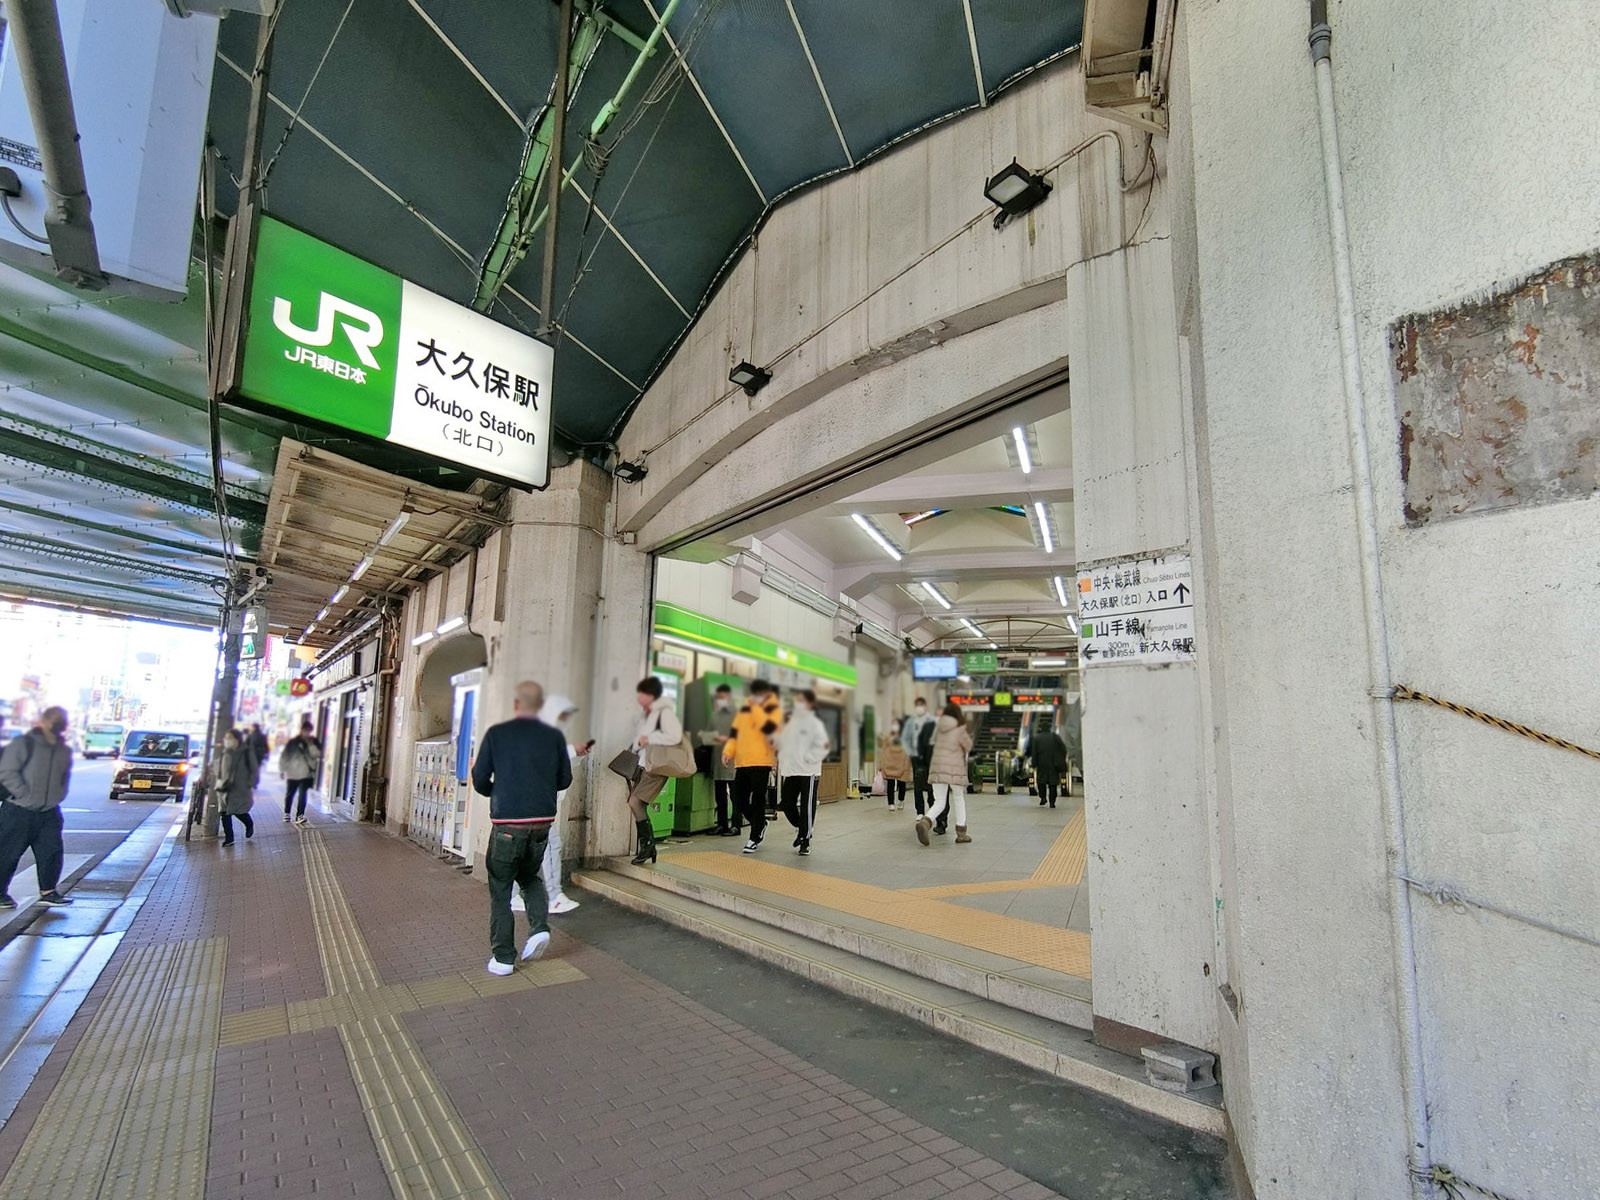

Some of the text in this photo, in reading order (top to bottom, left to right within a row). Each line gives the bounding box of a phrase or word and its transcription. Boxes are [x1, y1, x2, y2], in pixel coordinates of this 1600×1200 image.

[273, 290, 384, 371] JR
[284, 345, 367, 384] JR東日本
[415, 338, 540, 411] 大久保駅
[414, 383, 536, 445] Ōkubo Station
[442, 423, 504, 456] （北口）
[1175, 571, 1190, 580] Lines
[1146, 589, 1167, 604] 入口
[1096, 618, 1141, 638] 山手線
[1175, 621, 1187, 630] Line
[1140, 637, 1195, 654] 新大久保駅
